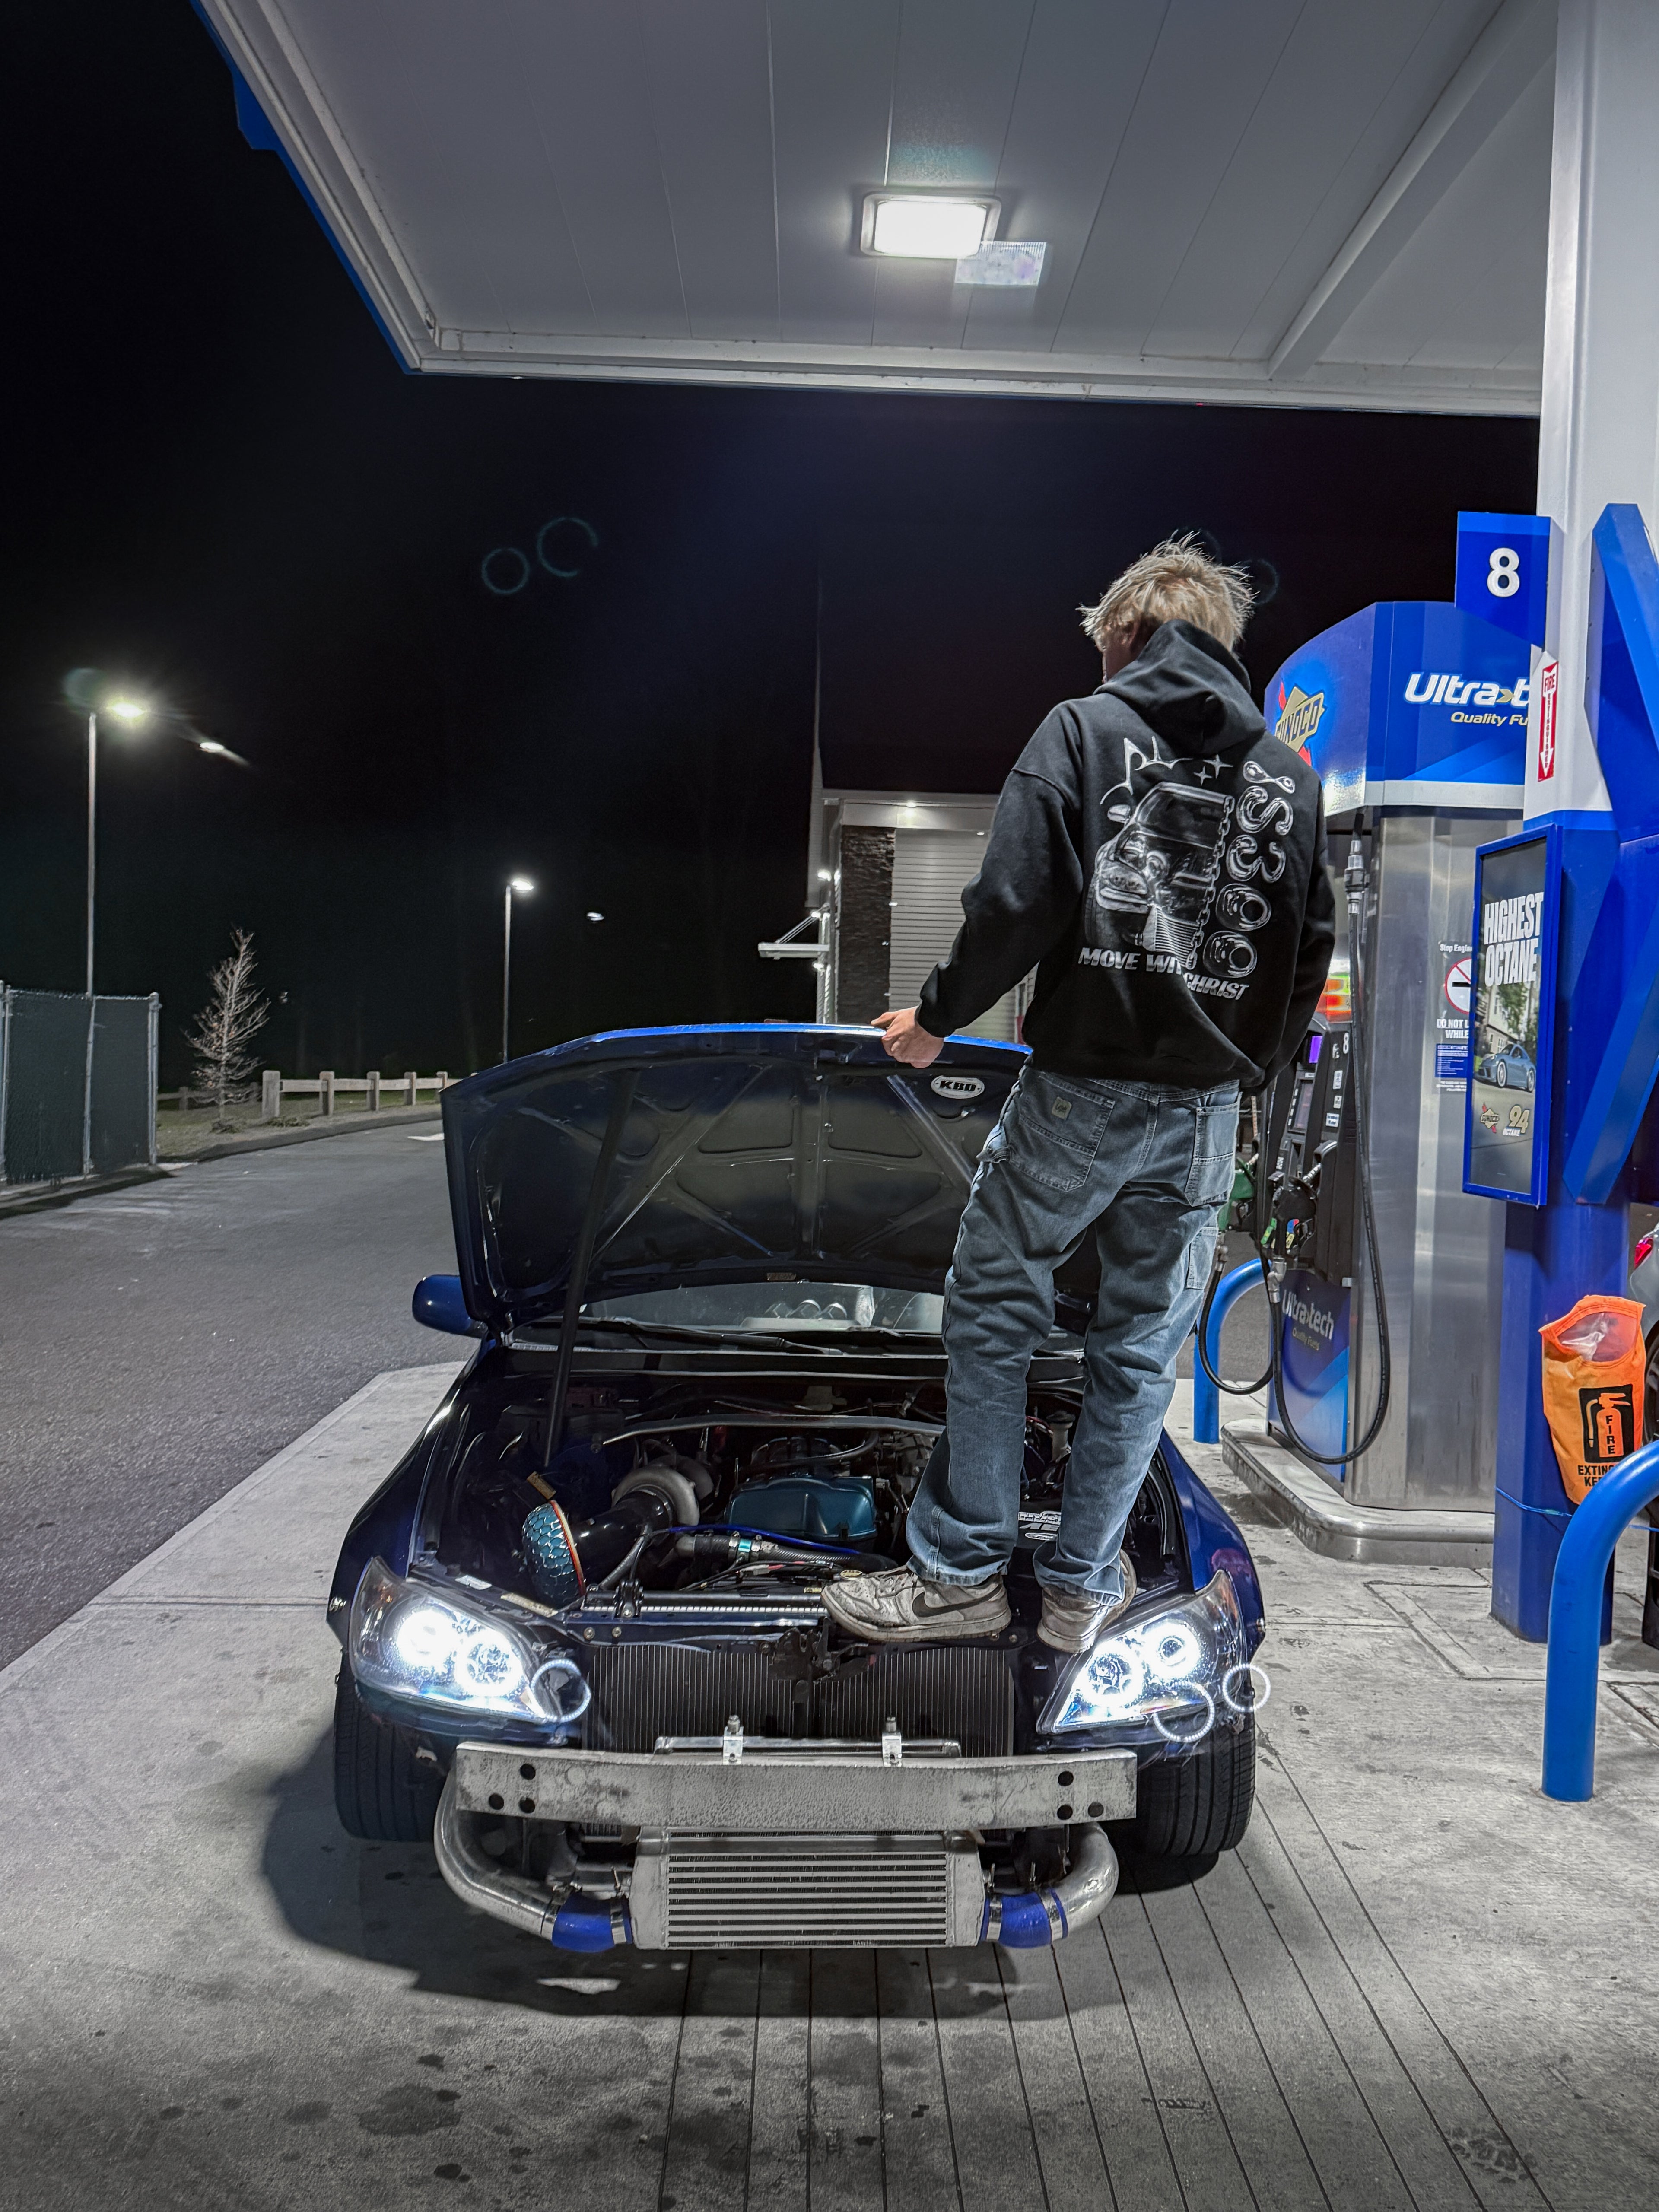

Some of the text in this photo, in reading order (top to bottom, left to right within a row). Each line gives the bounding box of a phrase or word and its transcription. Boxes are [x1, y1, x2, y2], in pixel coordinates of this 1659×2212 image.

[1487, 547, 1520, 597] 8
[1544, 674, 1555, 689] FIRE
[1450, 712, 1509, 727] Quality
[1484, 892, 1544, 945] HIGHEST
[1440, 944, 1453, 953] Stop
[1078, 947, 1141, 970] MOVE
[1184, 973, 1249, 1001] CHRIST
[1484, 938, 1538, 987] OCTANE
[1437, 1019, 1446, 1028] DO
[1448, 1019, 1464, 1028] NOT
[1445, 1030, 1469, 1039] WHILE
[1343, 1032, 1349, 1054] 8
[1510, 1105, 1530, 1133] 94
[1605, 1415, 1616, 1455] FIRE
